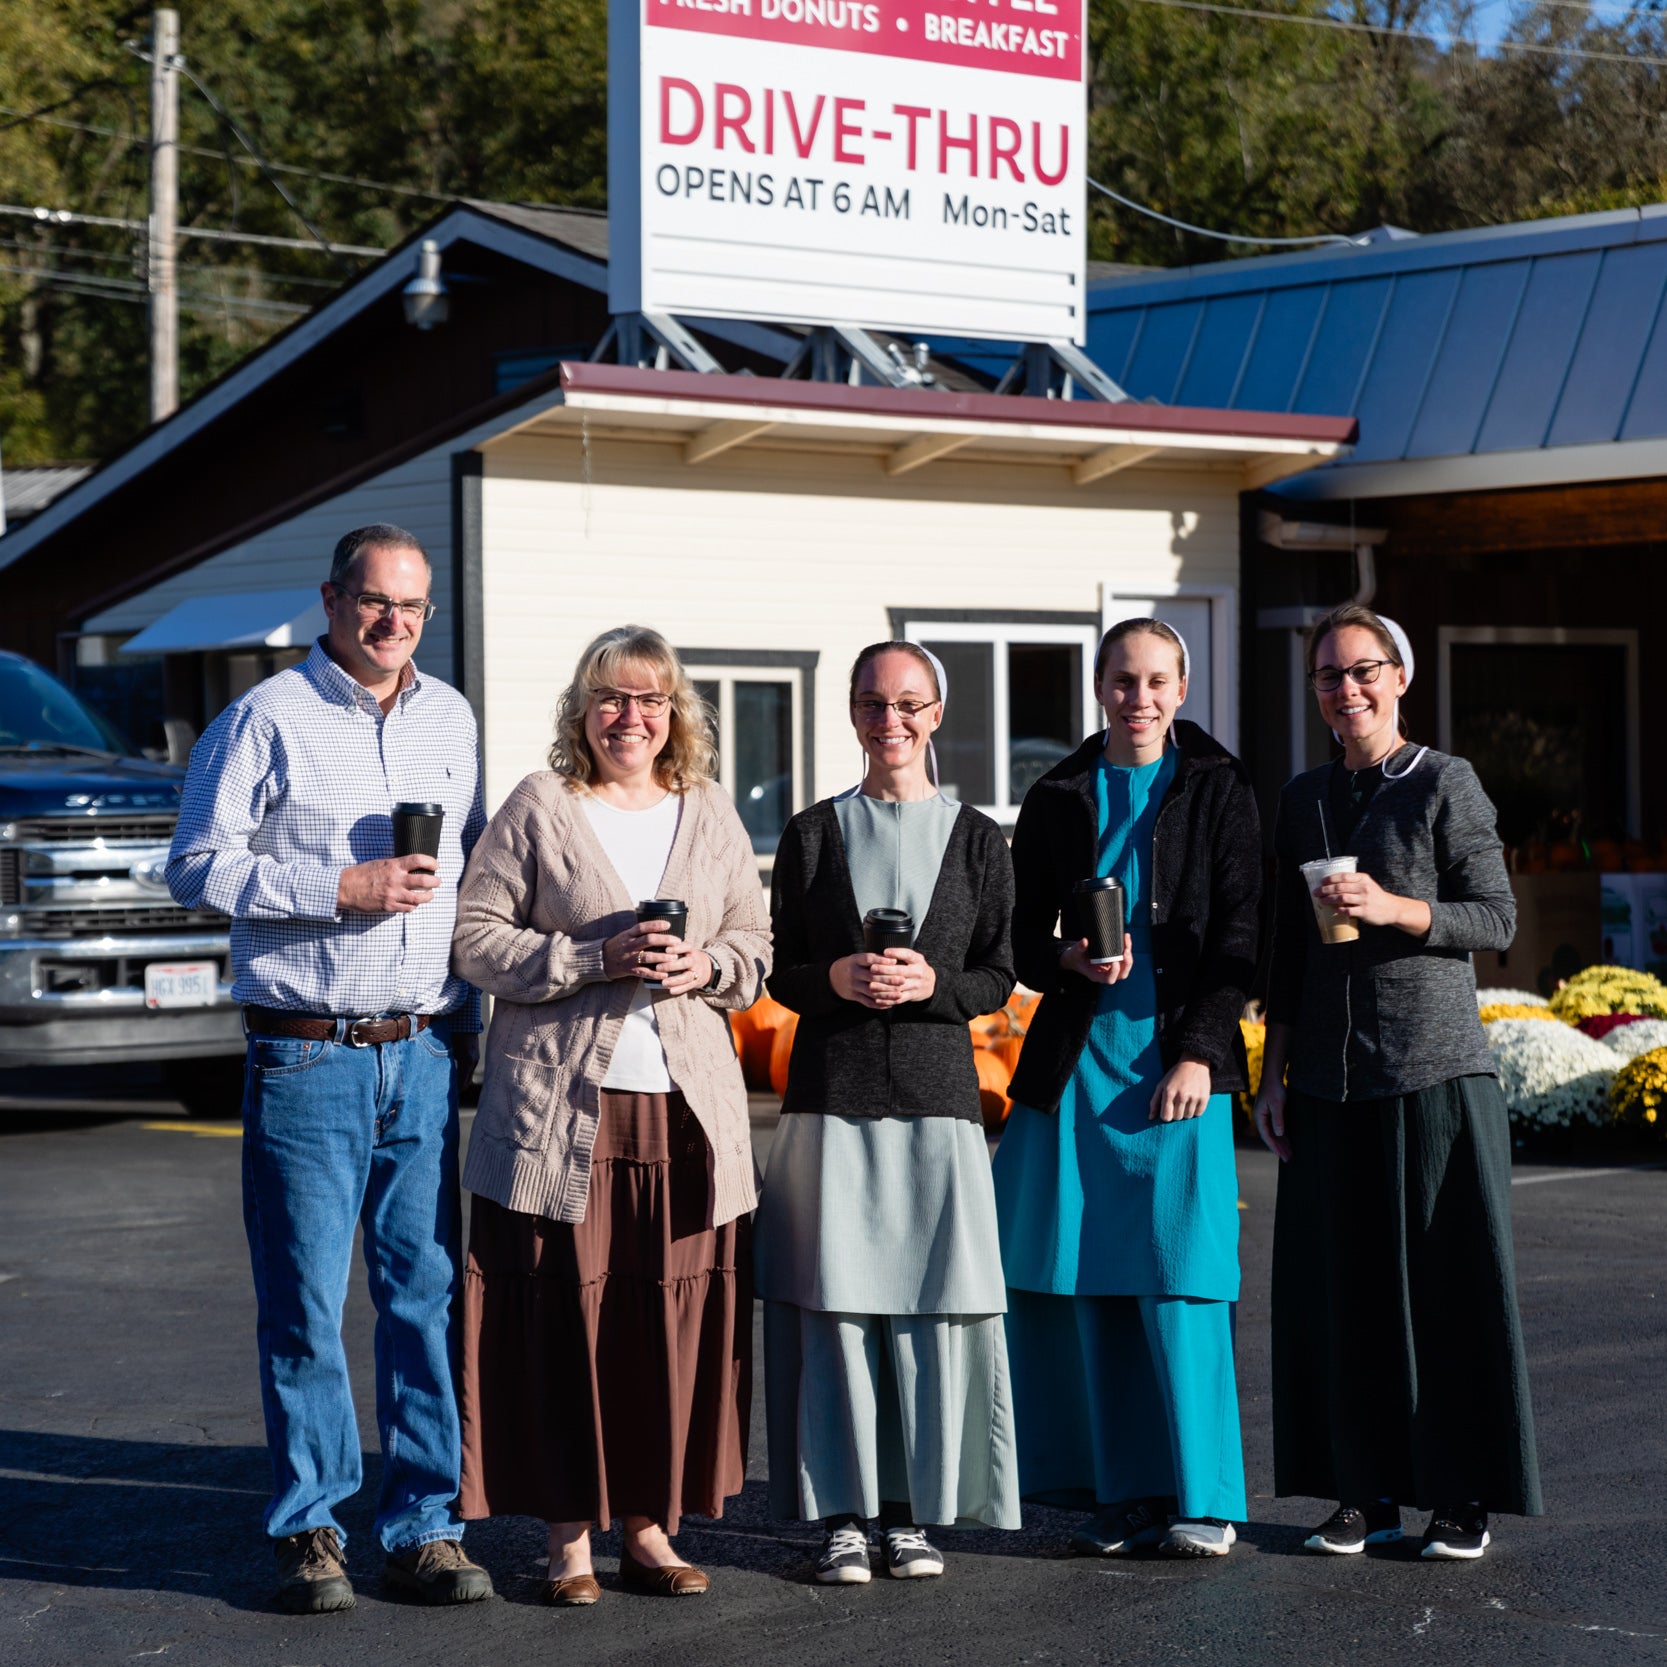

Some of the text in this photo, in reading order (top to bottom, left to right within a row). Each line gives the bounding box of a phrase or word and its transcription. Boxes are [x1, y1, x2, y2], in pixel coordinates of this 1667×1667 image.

[761, 0, 880, 34] DONUTS
[924, 12, 1069, 60] BREAKFAST
[659, 75, 1069, 187] DRIVE-THRU
[656, 163, 1071, 236] OPENS AT 6 AM Mon-Sat
